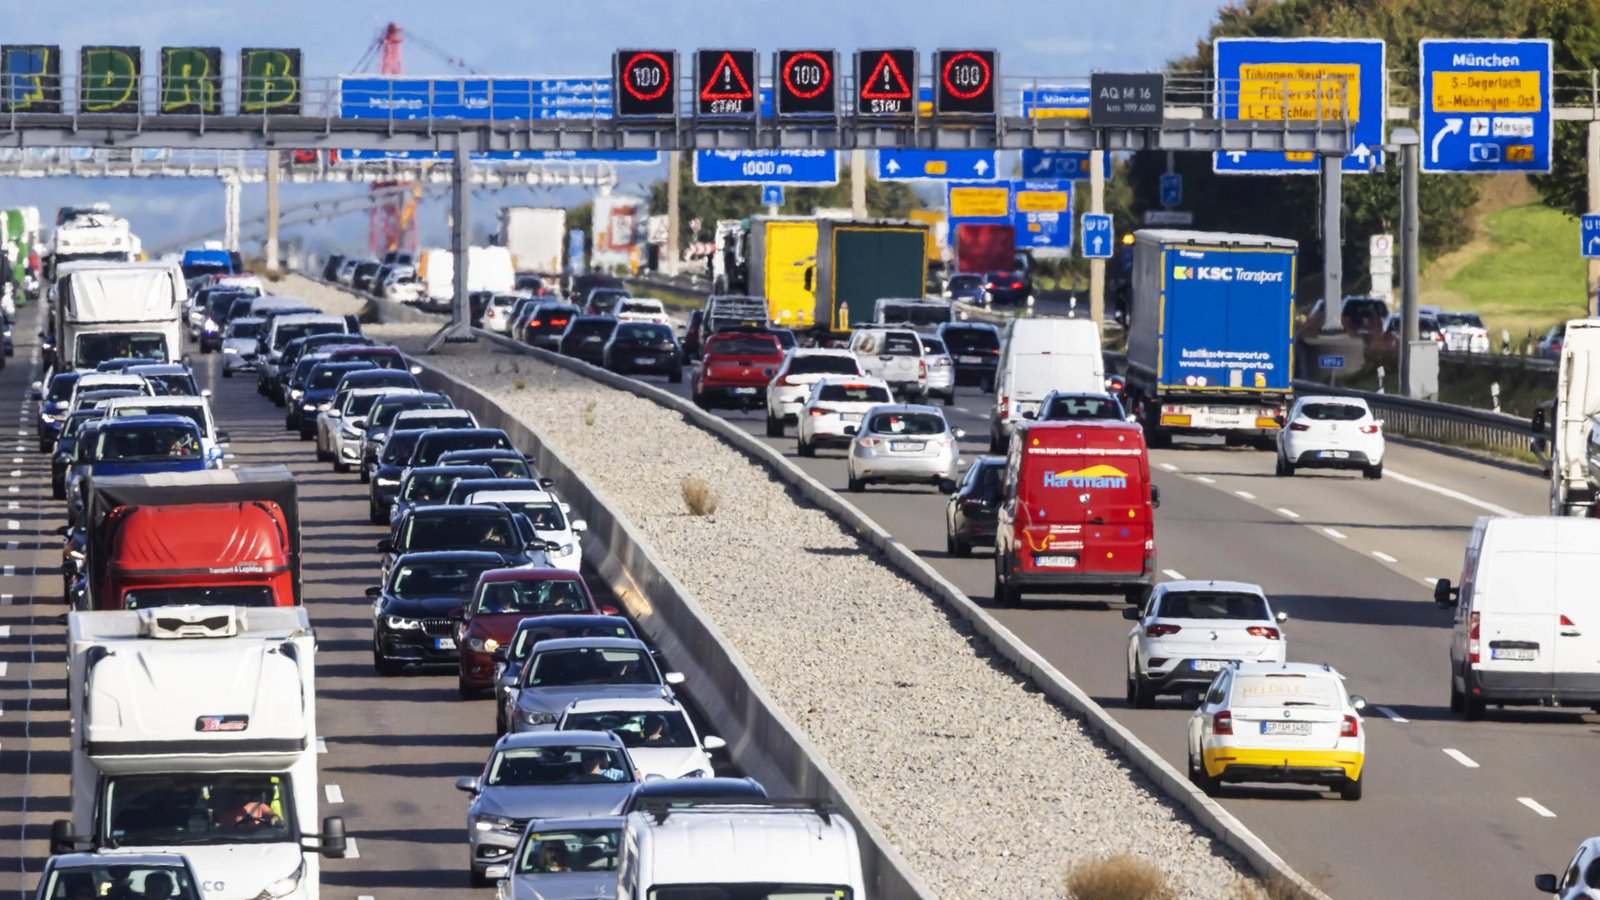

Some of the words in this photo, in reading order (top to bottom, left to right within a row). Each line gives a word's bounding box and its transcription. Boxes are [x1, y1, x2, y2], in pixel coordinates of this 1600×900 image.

[1453, 54, 1521, 68] München
[633, 66, 660, 87] 100
[793, 65, 820, 85] 100
[954, 65, 981, 85] 100
[1100, 87, 1121, 99] AQ
[1139, 87, 1152, 99] 16
[710, 100, 742, 113] STAU
[871, 100, 901, 112] STAU
[1106, 103, 1121, 113] km
[742, 161, 775, 176] 1000
[776, 164, 793, 175] m
[1197, 266, 1233, 281] KSC
[1235, 267, 1284, 285] Transport
[1043, 471, 1127, 489] Hartmann
[1267, 722, 1277, 733] GP
